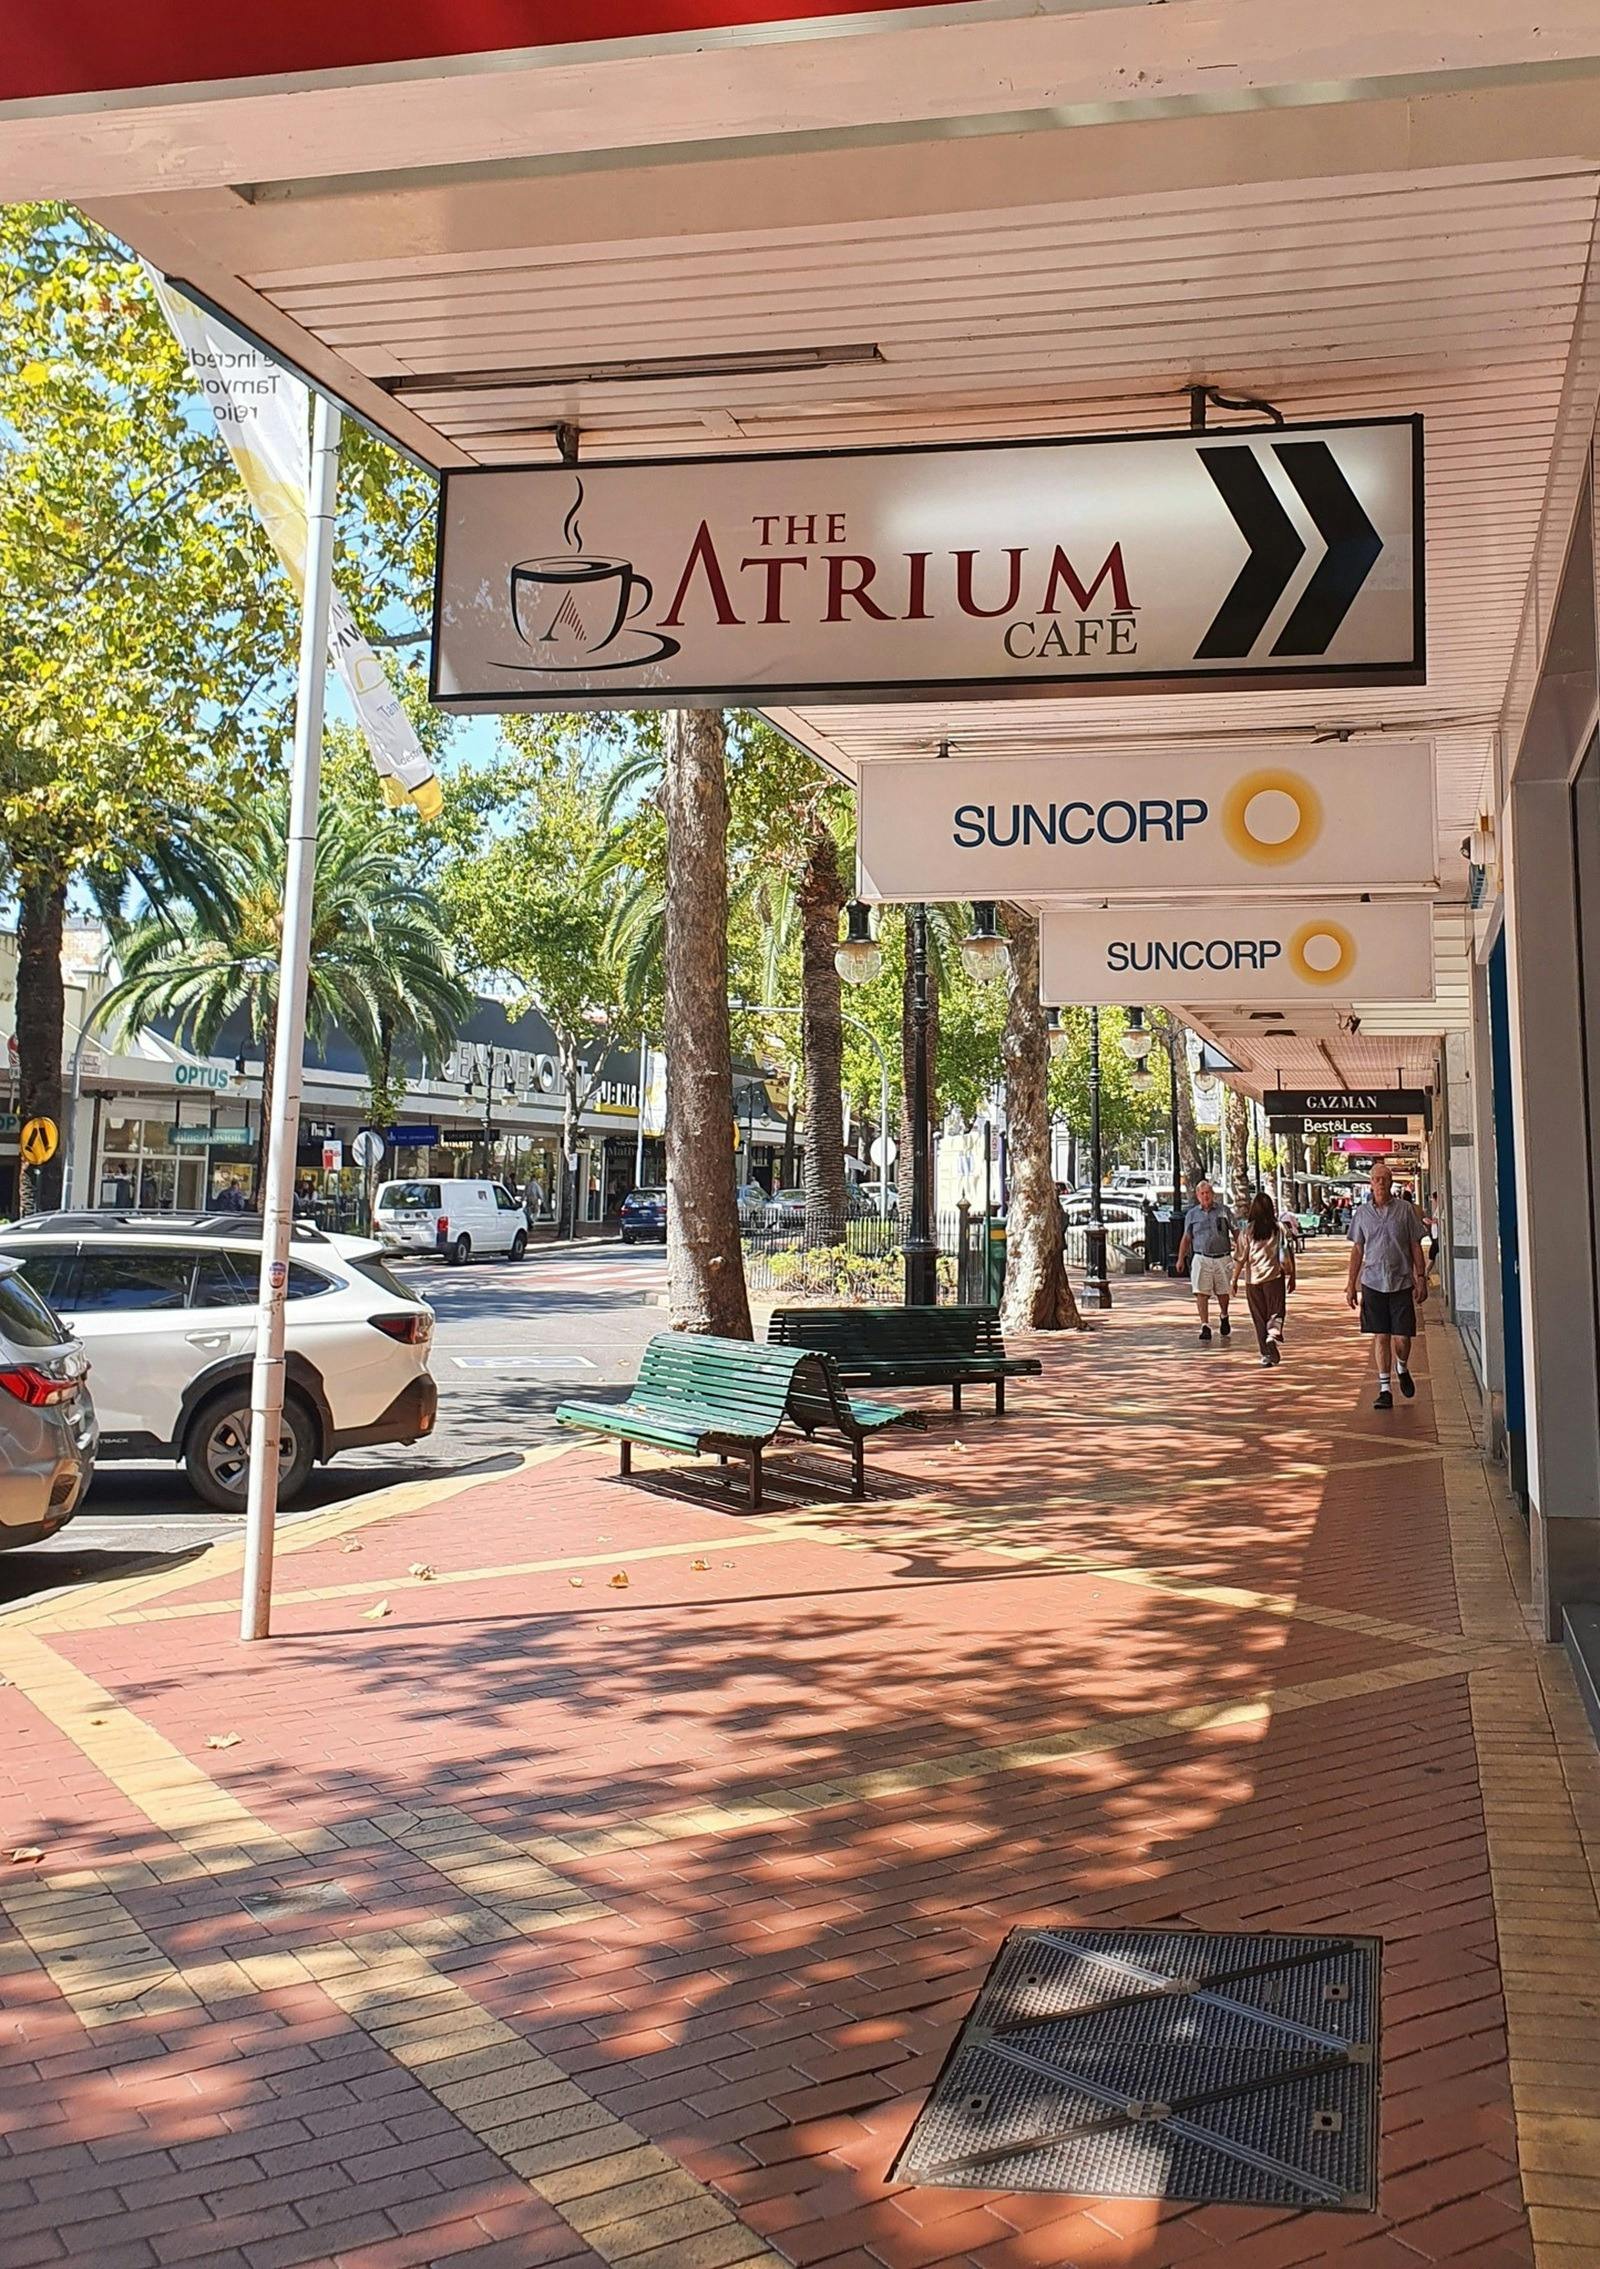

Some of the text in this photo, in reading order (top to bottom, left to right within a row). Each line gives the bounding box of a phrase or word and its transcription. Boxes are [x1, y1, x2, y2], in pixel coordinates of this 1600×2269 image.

[752, 513, 847, 546] THE
[656, 519, 1142, 627] ATRIUM
[953, 799, 1208, 847] SUNCORP
[1106, 940, 1282, 971] SUNCORP
[175, 1065, 228, 1088] OPTUS
[1306, 1096, 1377, 1109] GAZMAN
[1304, 1118, 1373, 1133] Best&Less
